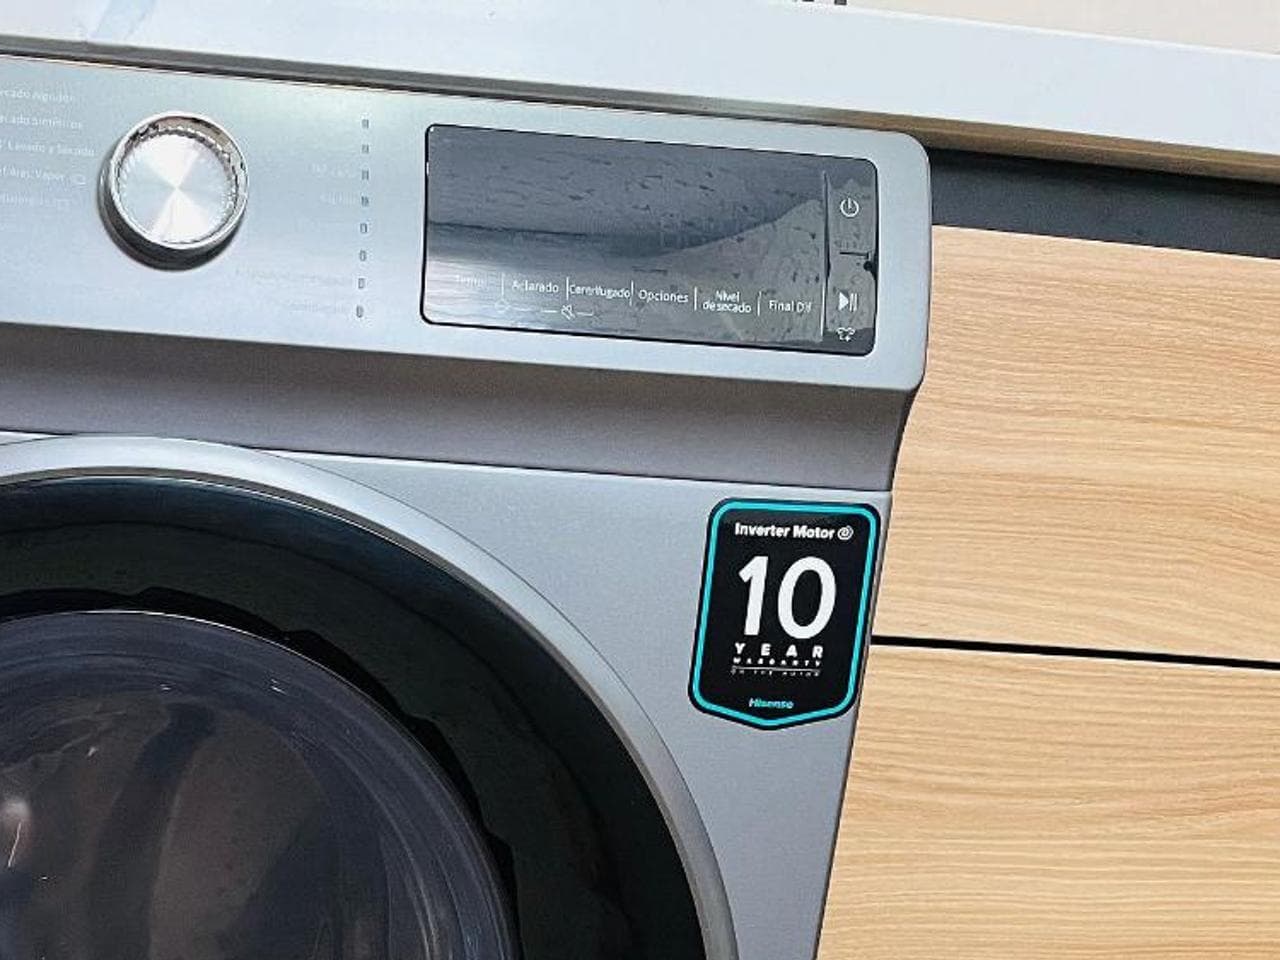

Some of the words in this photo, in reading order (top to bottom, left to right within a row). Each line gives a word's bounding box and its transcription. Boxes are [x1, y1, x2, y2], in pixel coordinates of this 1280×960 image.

[638, 289, 689, 303] Opciones
[769, 300, 794, 312] Final
[735, 522, 791, 537] Inverter
[793, 525, 835, 540] Motor
[738, 556, 837, 639] 10
[734, 642, 824, 659] YEAR
